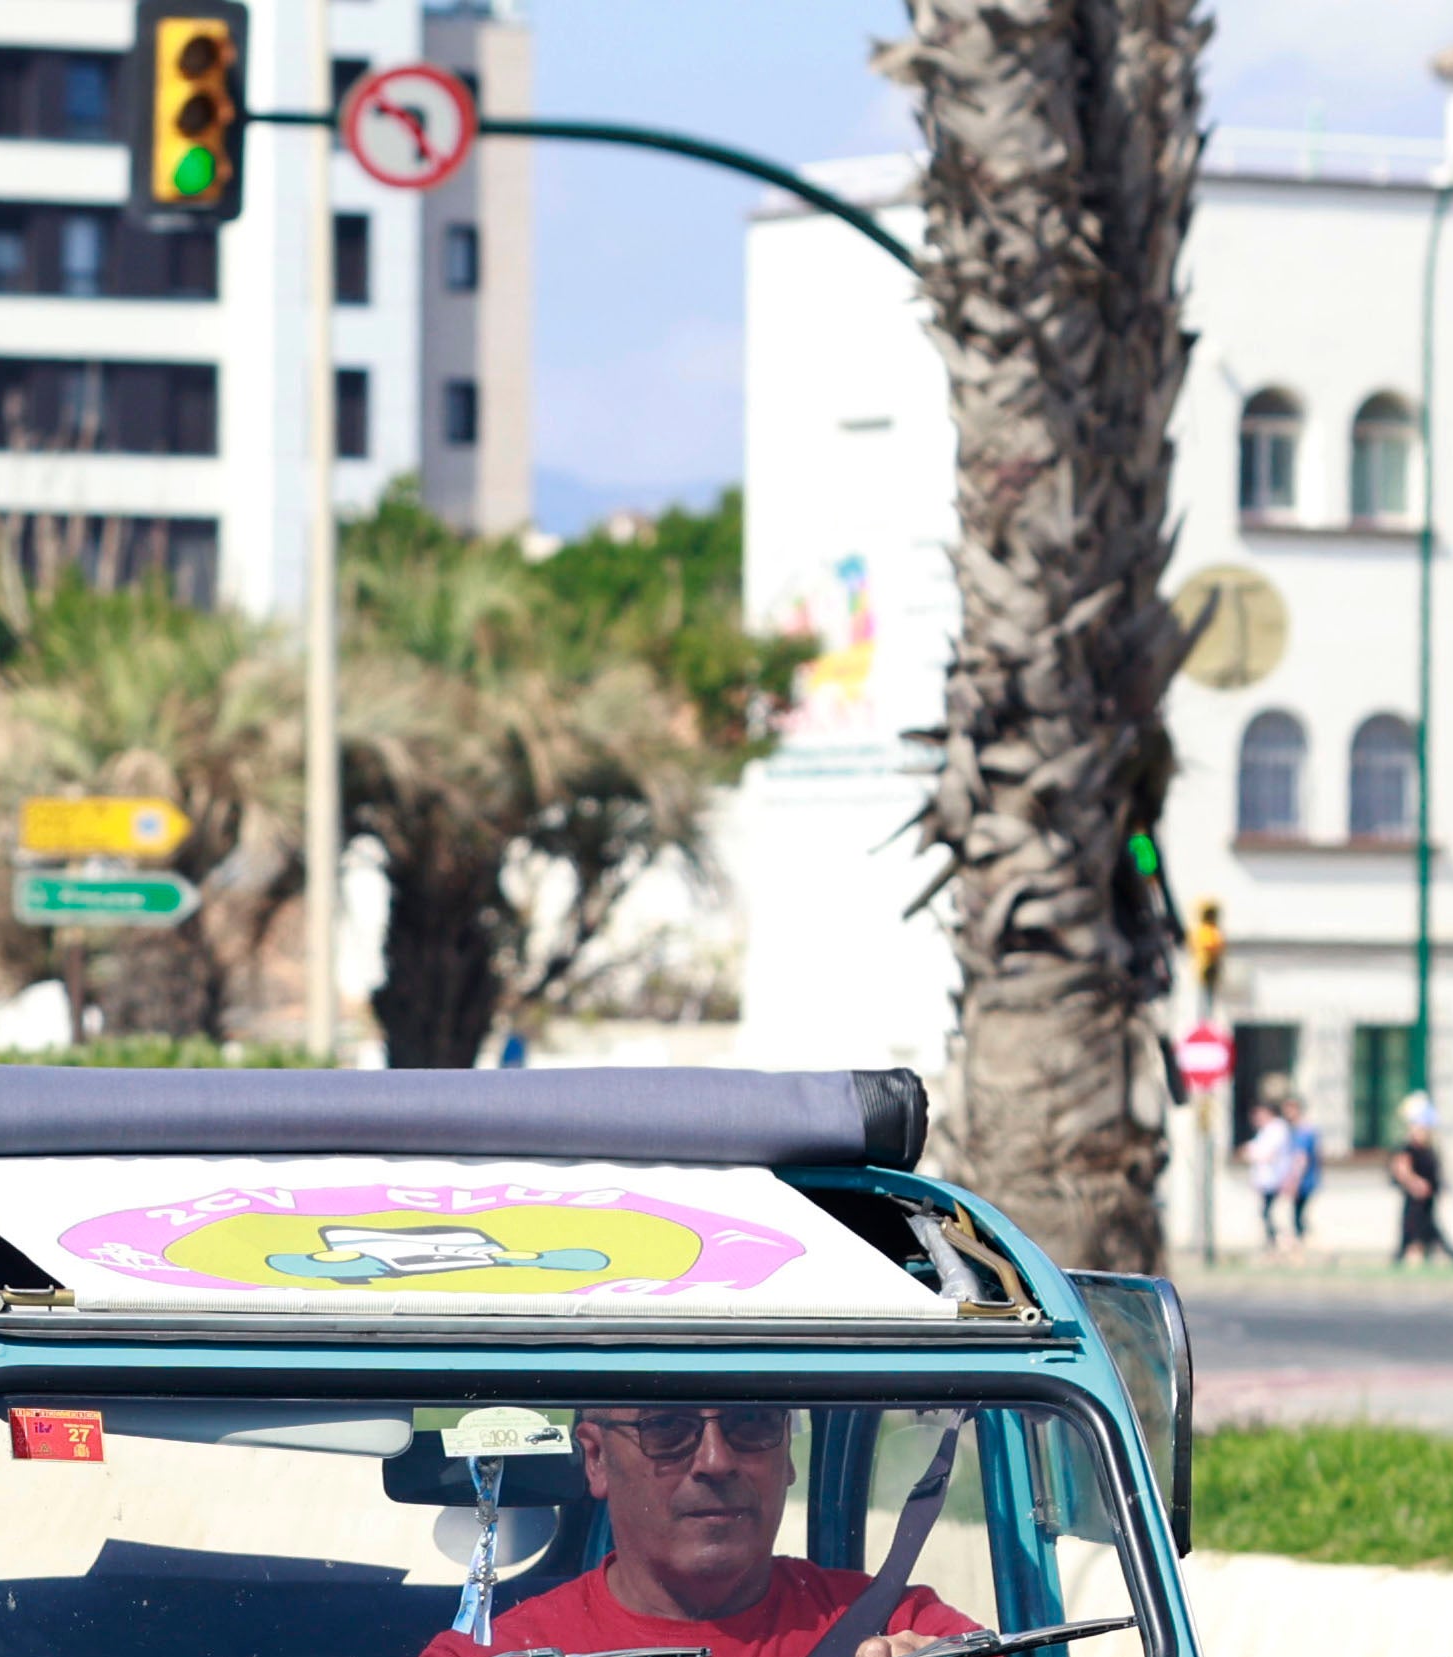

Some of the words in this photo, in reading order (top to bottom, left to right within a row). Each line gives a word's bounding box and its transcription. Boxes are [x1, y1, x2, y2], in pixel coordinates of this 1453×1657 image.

[144, 1188, 297, 1227] 2CV
[385, 1184, 629, 1211] CLUB
[68, 1428, 90, 1443] 27
